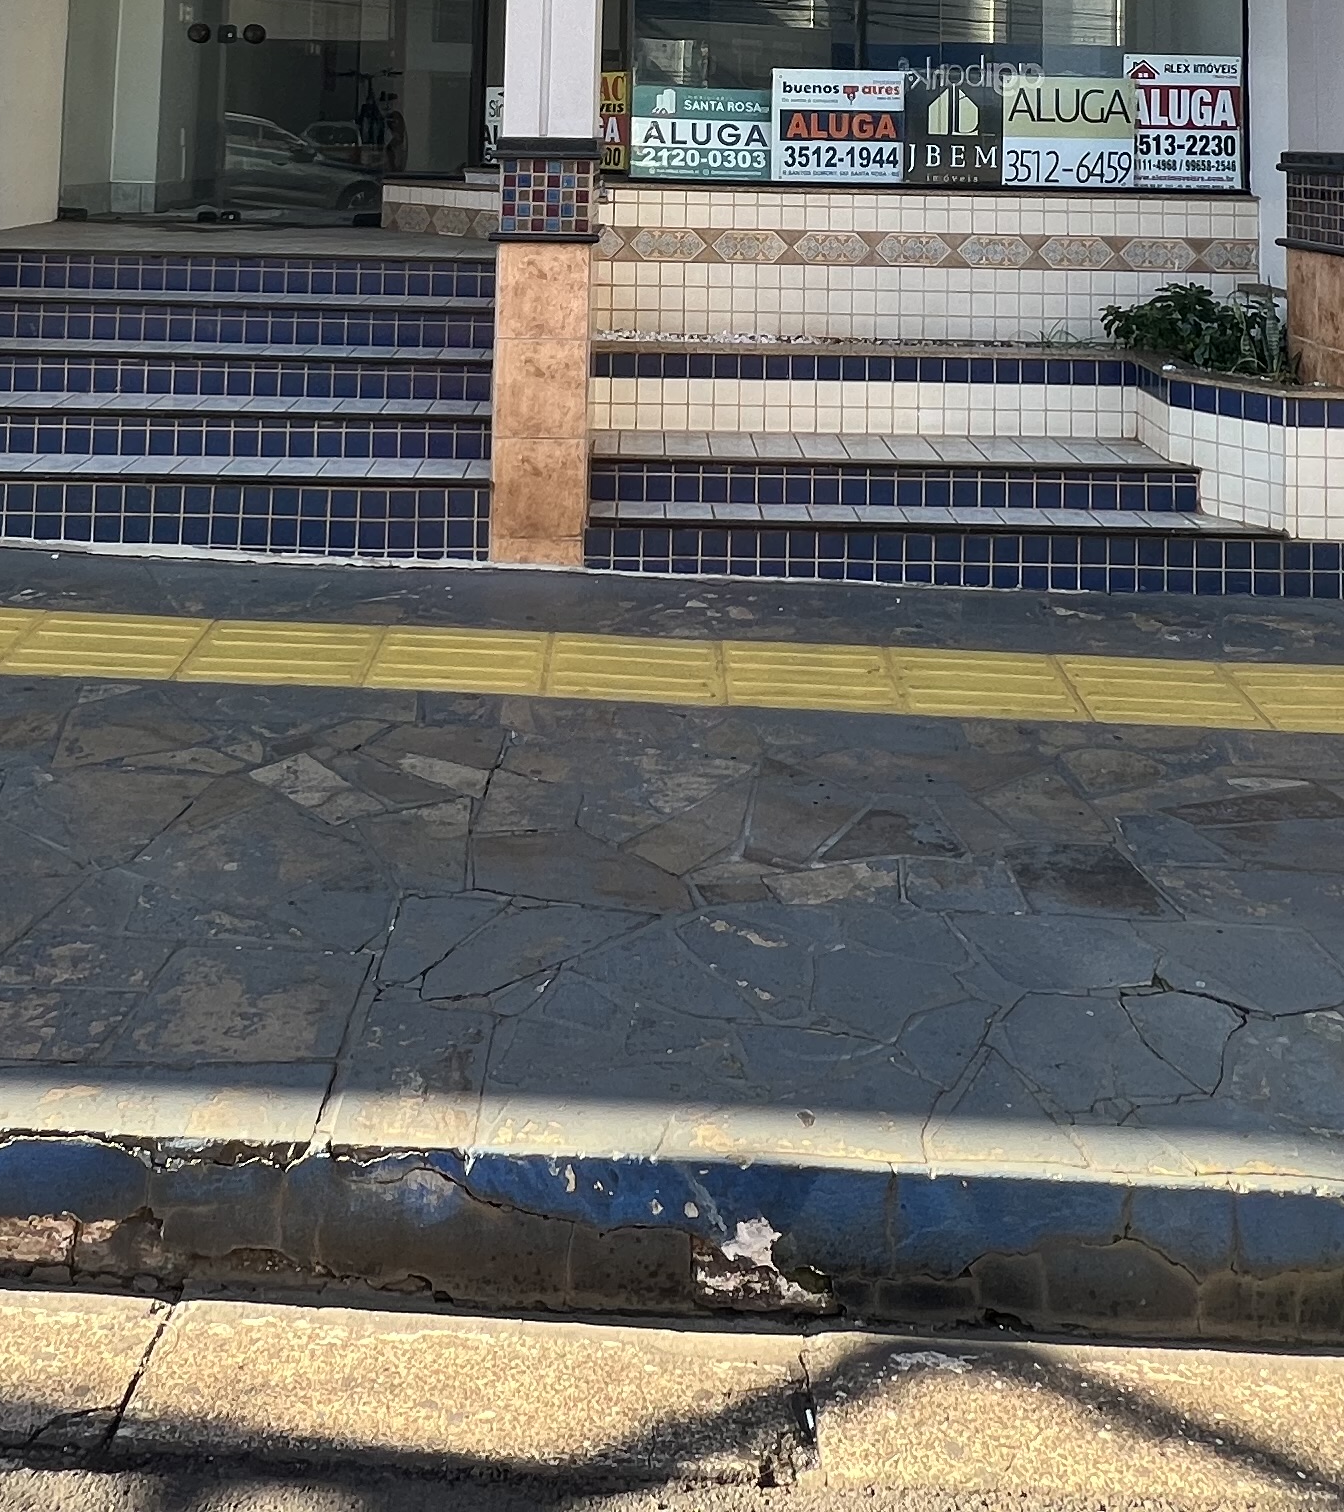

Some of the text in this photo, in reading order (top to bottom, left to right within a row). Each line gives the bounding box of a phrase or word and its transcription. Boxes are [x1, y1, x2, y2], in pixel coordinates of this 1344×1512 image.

[1164, 63, 1191, 74] ALEX
[782, 81, 840, 94] buenos
[683, 99, 763, 114] SANTA ROSA
[1008, 88, 1132, 124] ALUGA
[1136, 88, 1237, 127] ALUGA
[642, 120, 769, 148] ALUGA
[786, 112, 897, 140] ALUGA
[783, 145, 899, 169] 3512-1944
[1135, 133, 1236, 157] 513-2230
[641, 147, 767, 169] 2120-0303
[1005, 149, 1133, 184] 3512-6459
